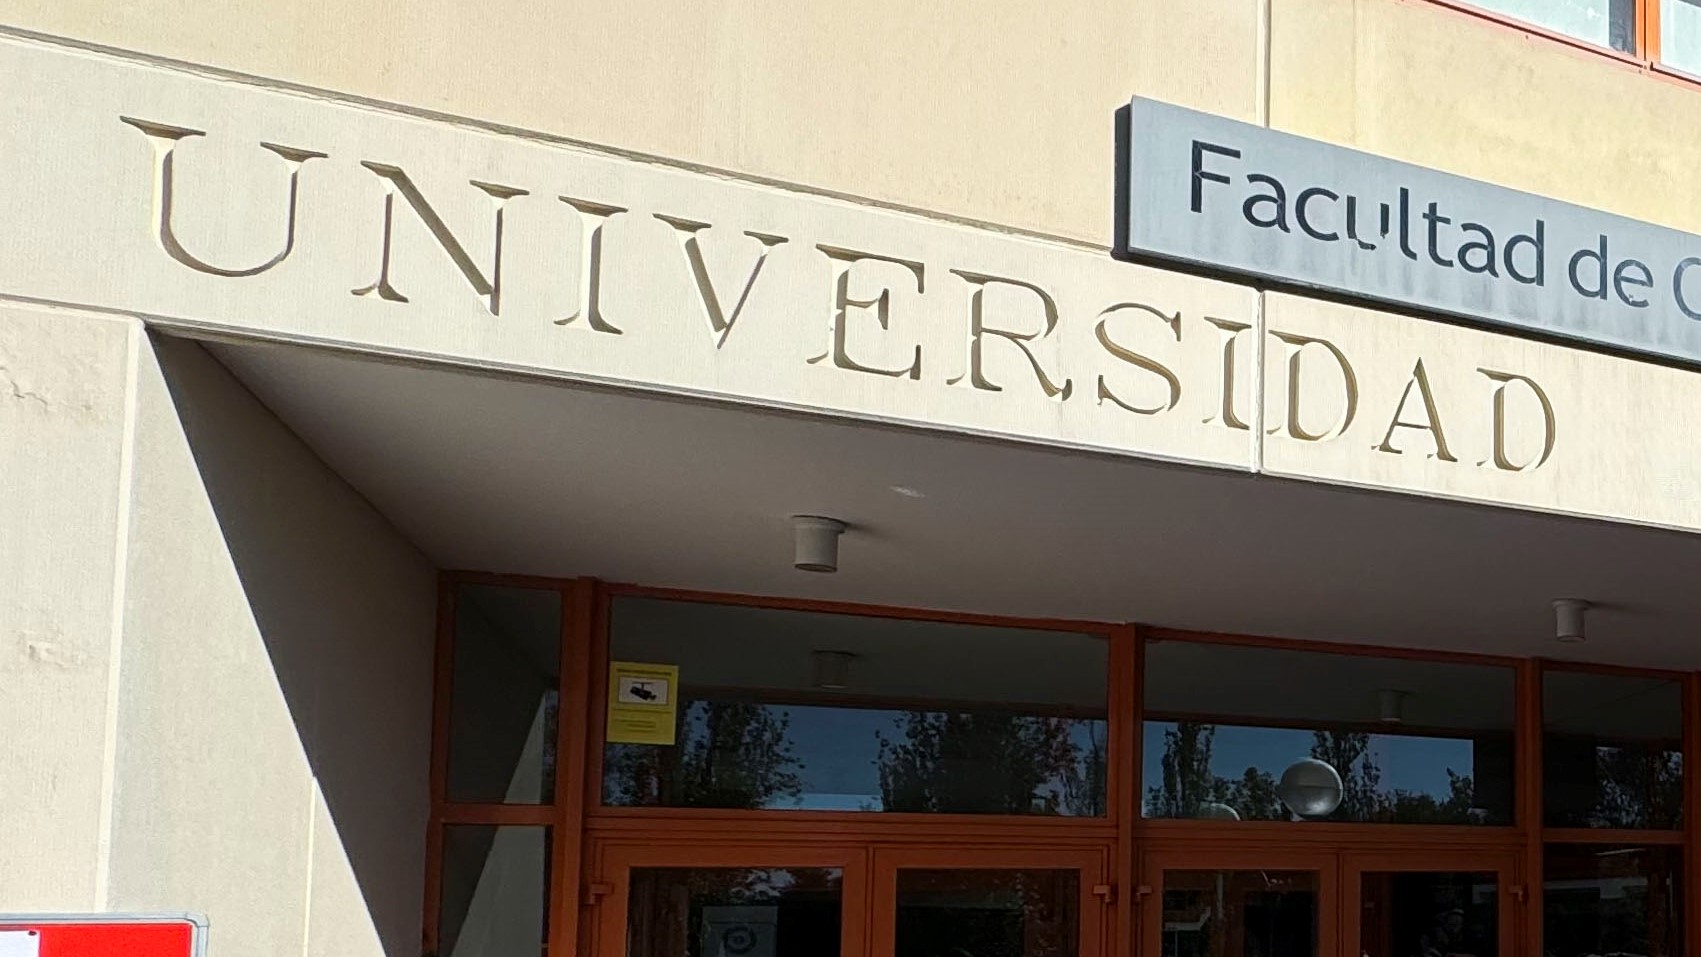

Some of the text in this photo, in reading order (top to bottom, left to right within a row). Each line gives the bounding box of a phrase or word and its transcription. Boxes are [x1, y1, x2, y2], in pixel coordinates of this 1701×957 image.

[119, 115, 1557, 473] UNIVERSIDAD
[1190, 139, 1545, 288] Facultad
[1568, 234, 1654, 308] de
